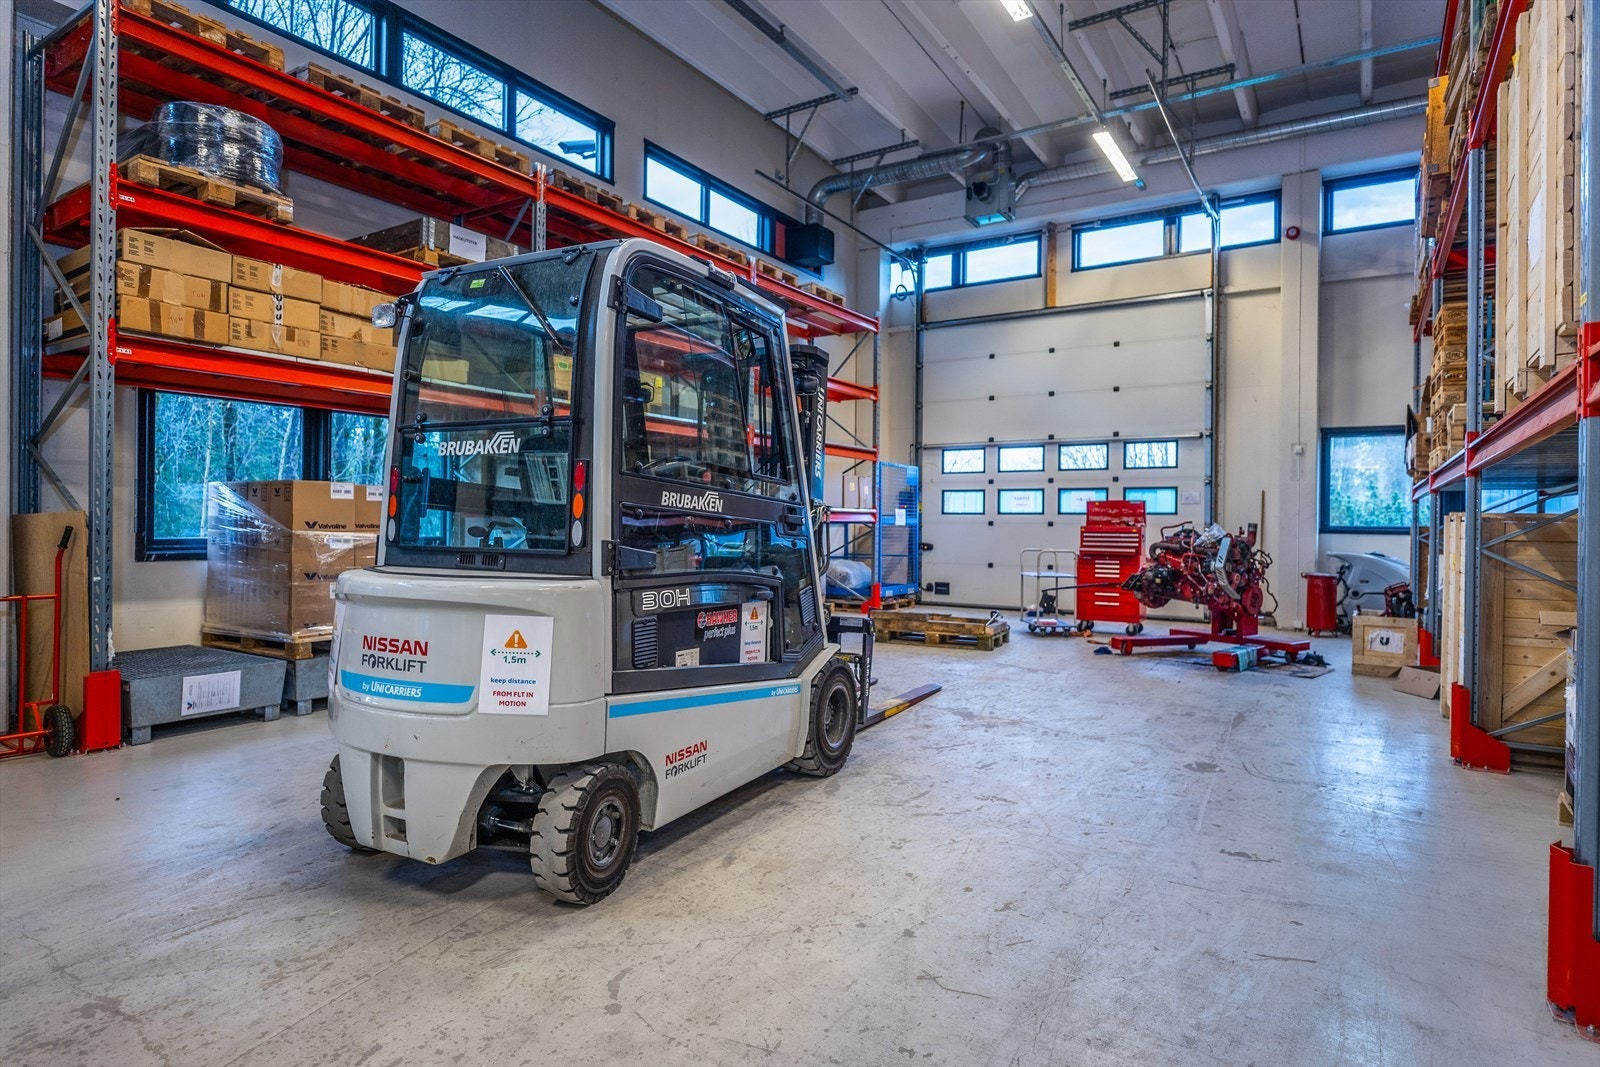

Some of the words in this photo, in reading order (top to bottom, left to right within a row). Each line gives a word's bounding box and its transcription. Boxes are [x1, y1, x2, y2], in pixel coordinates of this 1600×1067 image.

[438, 431, 521, 456] BRUBAKKEN
[815, 386, 825, 480] UNICARRIERS
[661, 491, 723, 513] BRUBAKKEN
[642, 588, 691, 611] 30H
[724, 624, 736, 638] plus
[362, 635, 428, 656] NISSAN
[361, 653, 427, 673] FORKLIFT
[503, 656, 527, 664] 1,5m
[362, 682, 370, 692] by
[371, 681, 422, 697] UNICARRIERS
[665, 740, 708, 767] NISSAN
[665, 753, 707, 780] FORKLIFT
